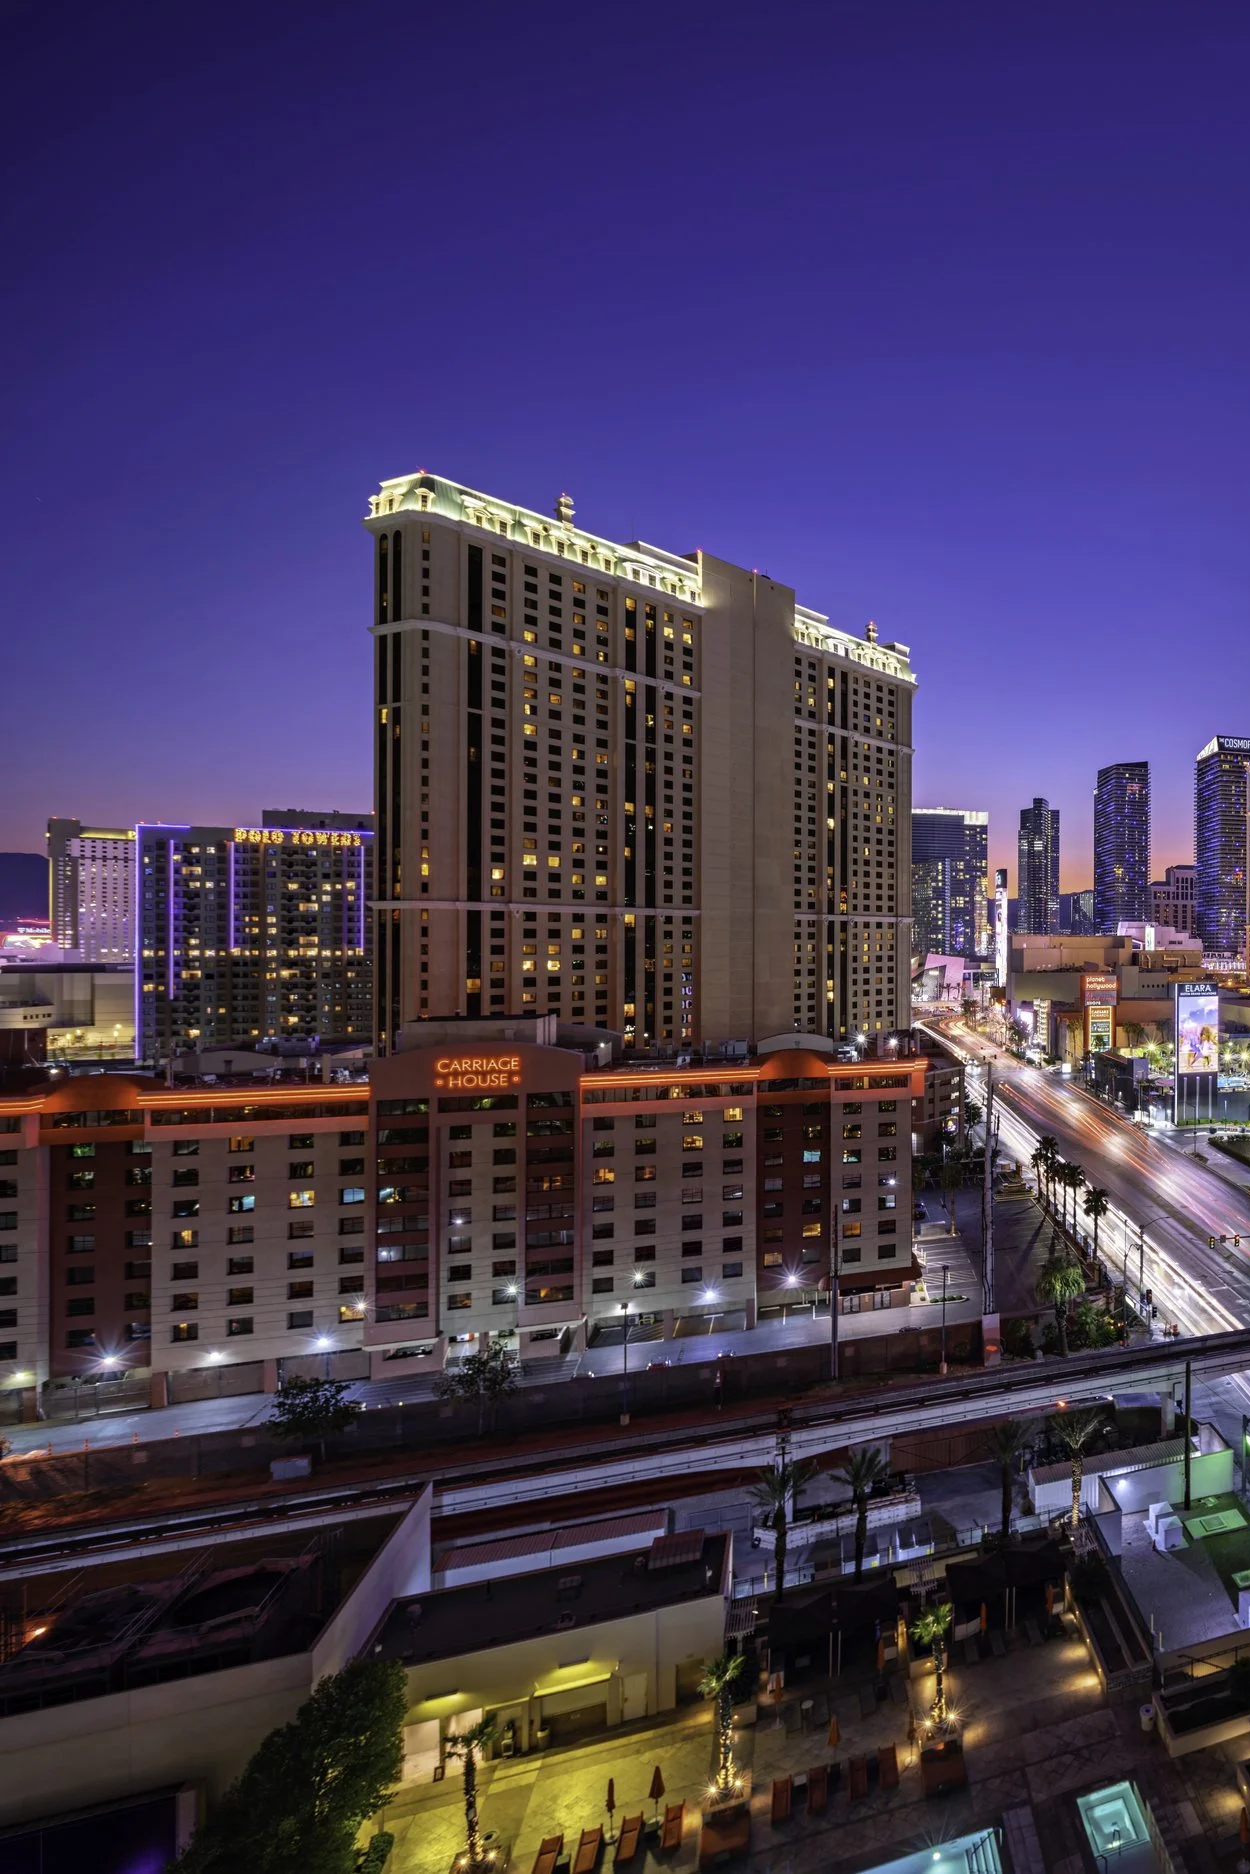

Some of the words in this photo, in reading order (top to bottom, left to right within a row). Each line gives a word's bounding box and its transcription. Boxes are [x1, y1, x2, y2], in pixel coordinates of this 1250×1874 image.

[234, 828, 285, 844] POLO
[291, 831, 362, 846] TOWERS
[1086, 976, 1106, 984] planet
[1086, 982, 1117, 991] hollywood
[437, 1057, 520, 1073] CARRIAGE
[449, 1074, 509, 1088] HOUSE
